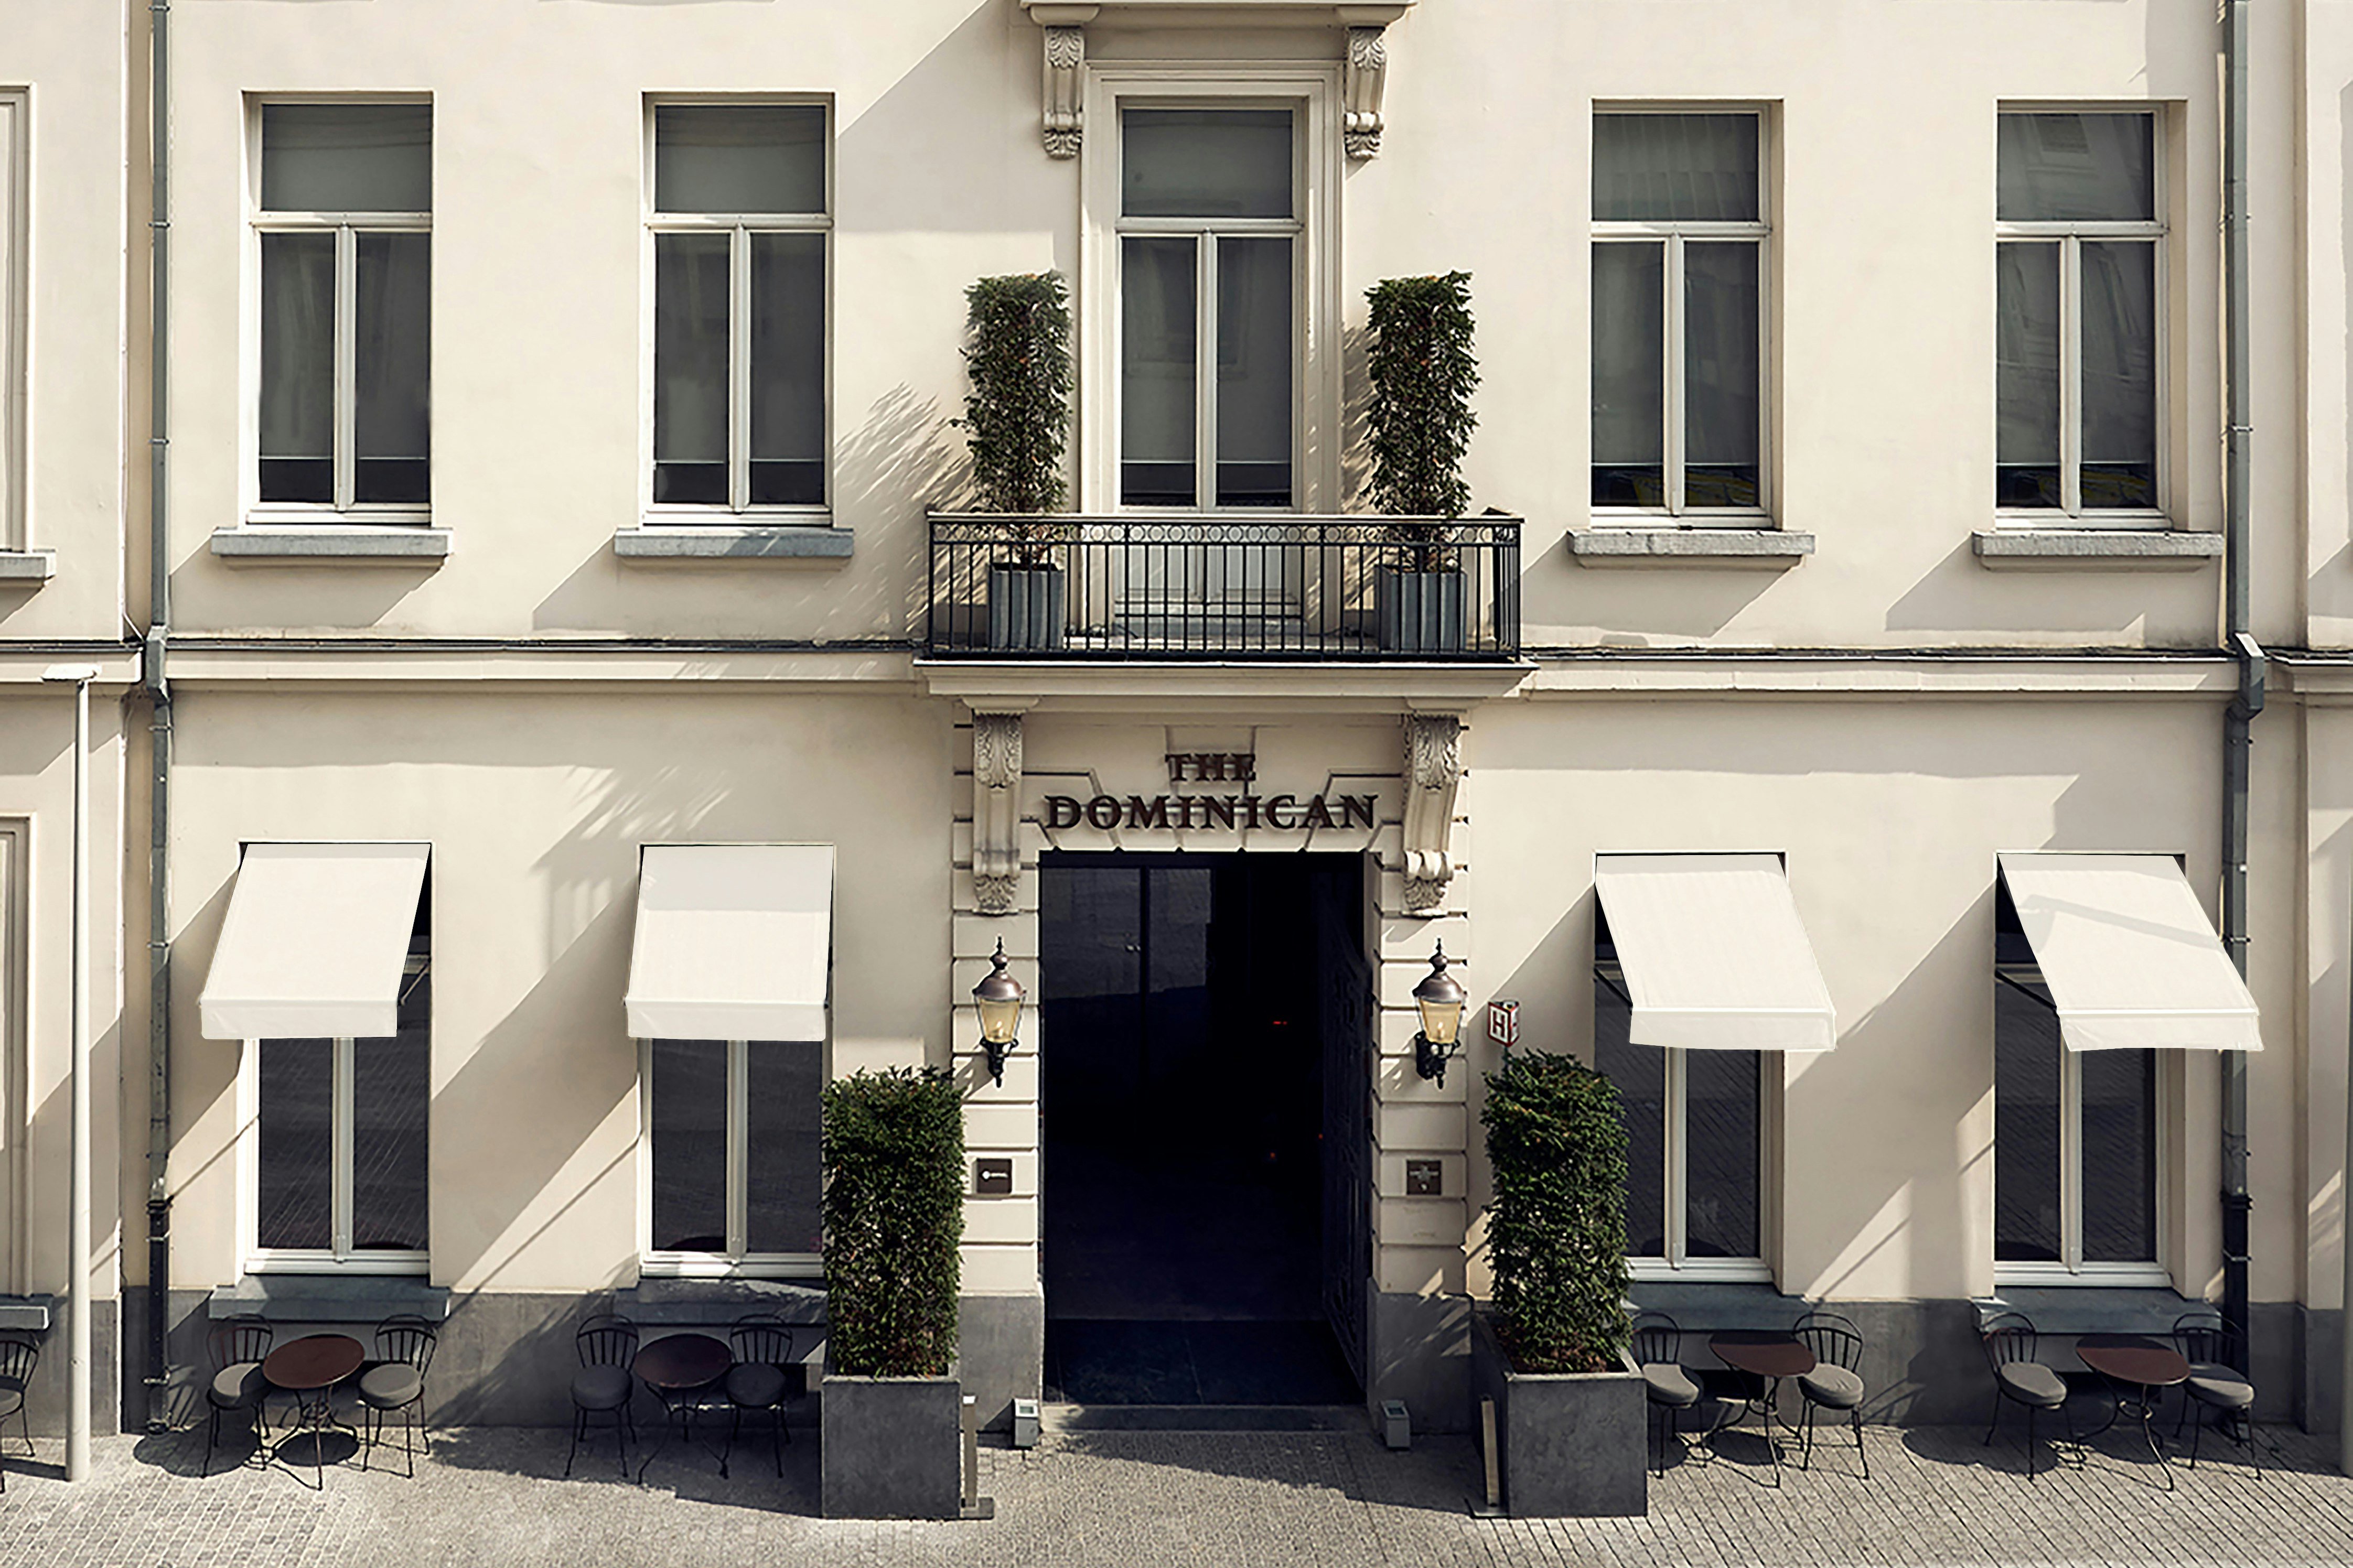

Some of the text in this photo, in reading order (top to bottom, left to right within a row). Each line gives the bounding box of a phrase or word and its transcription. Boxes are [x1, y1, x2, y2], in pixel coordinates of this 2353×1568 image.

[1165, 753, 1256, 782] THE
[1045, 794, 1379, 829] DOMINICAN
[1492, 1010, 1506, 1038] H
